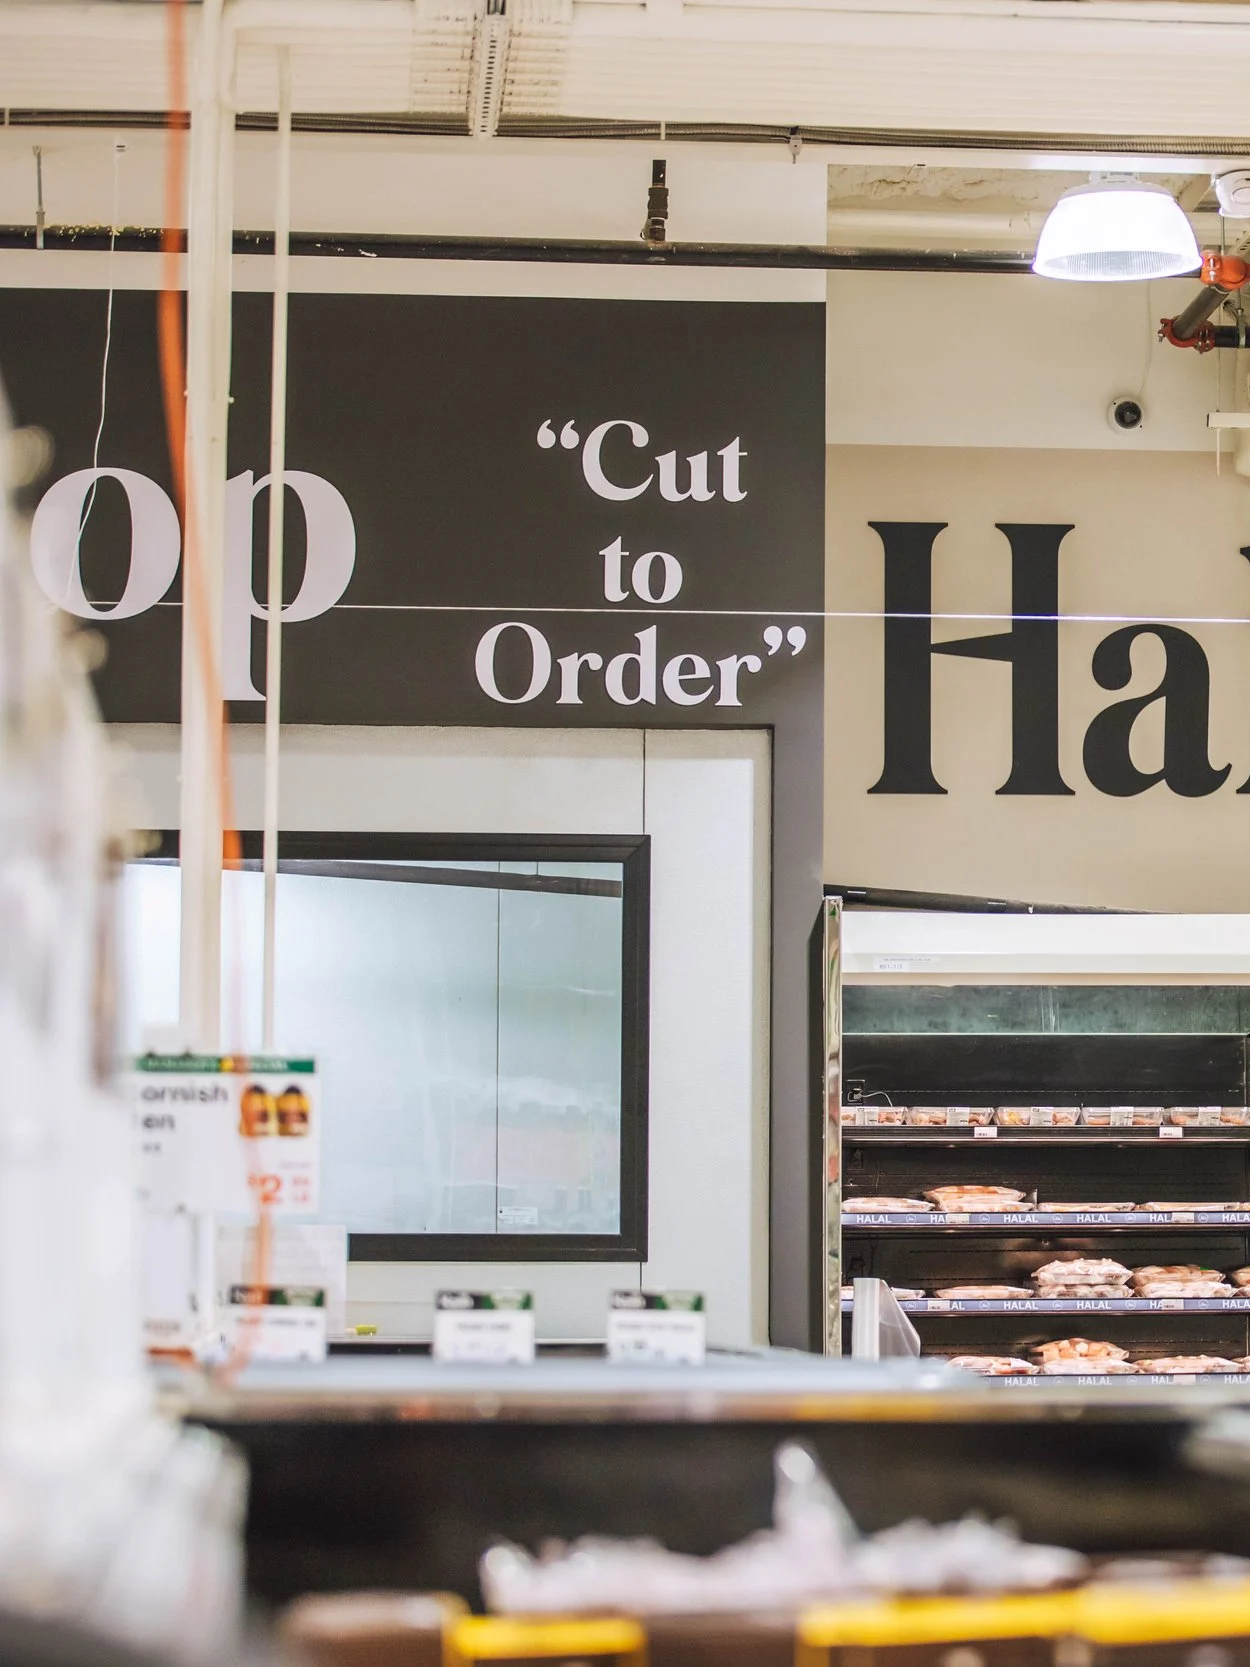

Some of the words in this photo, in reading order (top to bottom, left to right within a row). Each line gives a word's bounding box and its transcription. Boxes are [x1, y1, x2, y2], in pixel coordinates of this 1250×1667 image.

[536, 419, 748, 503] “Cut
[598, 535, 684, 604] to
[29, 466, 357, 701] op
[474, 621, 807, 707] Order”
[141, 1083, 229, 1104] ornish
[142, 1113, 176, 1131] en
[856, 1213, 892, 1224] HALAL
[1003, 1213, 1039, 1224] HALAL
[1076, 1212, 1112, 1223] HALAL
[1003, 1300, 1039, 1310] HALAL
[1076, 1300, 1112, 1310] HALAL
[1004, 1376, 1039, 1386] HALAL
[1077, 1376, 1112, 1386] HALAL
